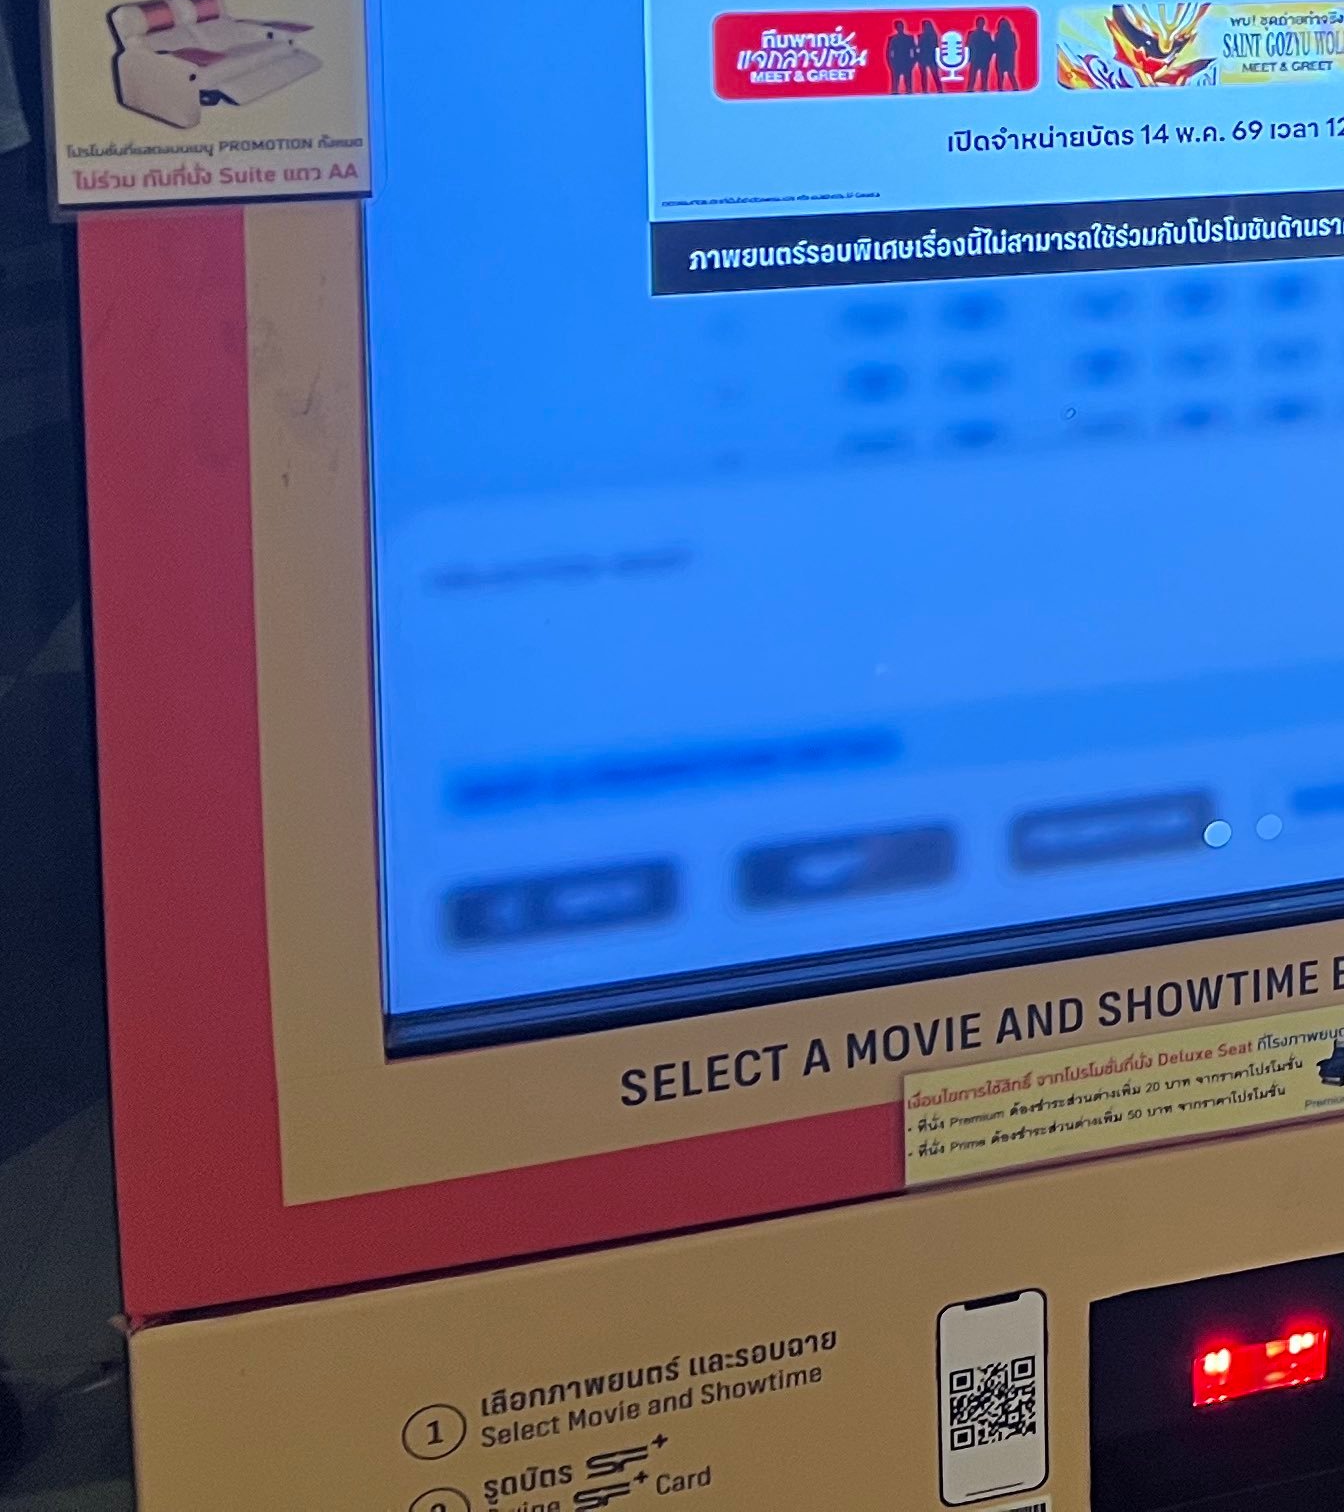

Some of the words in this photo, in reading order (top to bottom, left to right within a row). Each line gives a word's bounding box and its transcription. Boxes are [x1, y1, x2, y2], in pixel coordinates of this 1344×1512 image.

[761, 25, 856, 50] ทีมพากย์
[1223, 32, 1262, 59] SAINT
[1266, 31, 1311, 58] GOZYU
[750, 70, 792, 83] MEET
[806, 69, 856, 82] GREET
[1242, 62, 1275, 74] MEET
[1292, 60, 1334, 72] GREET
[218, 137, 313, 154] PROMOTION
[947, 127, 1134, 153] เปิดจำหน่ายบัตร
[1141, 125, 1169, 144] 14
[1175, 124, 1225, 142] พ.ค.
[1232, 120, 1263, 140] 69
[1270, 120, 1319, 140] เวลา
[72, 168, 137, 191] ไม่ร่วม
[218, 167, 277, 185] Suite
[328, 162, 359, 181] AA
[620, 1042, 789, 1107] SELECT
[803, 1038, 831, 1077] A
[846, 1011, 983, 1070] MOVIE
[996, 996, 1084, 1046] AND
[1098, 959, 1319, 1028] SHOWTIME
[1158, 1048, 1214, 1068] Deluxe
[1217, 1041, 1253, 1056] Seat
[950, 1109, 1005, 1128] Premium
[1145, 1082, 1160, 1094] 20
[1165, 1076, 1191, 1090] บาท
[1127, 1108, 1143, 1121] 50
[1147, 1103, 1173, 1118] บาท
[480, 1354, 682, 1418] เลือกภาพยนตร์
[689, 1328, 838, 1380] และรอบฉาย
[481, 1417, 561, 1448] Select
[568, 1400, 641, 1432] Movie
[647, 1389, 694, 1415] and
[701, 1364, 823, 1408] Showtime
[426, 1420, 443, 1446] 1
[484, 1464, 573, 1505] รูดบัตร
[656, 1466, 713, 1496] Card
